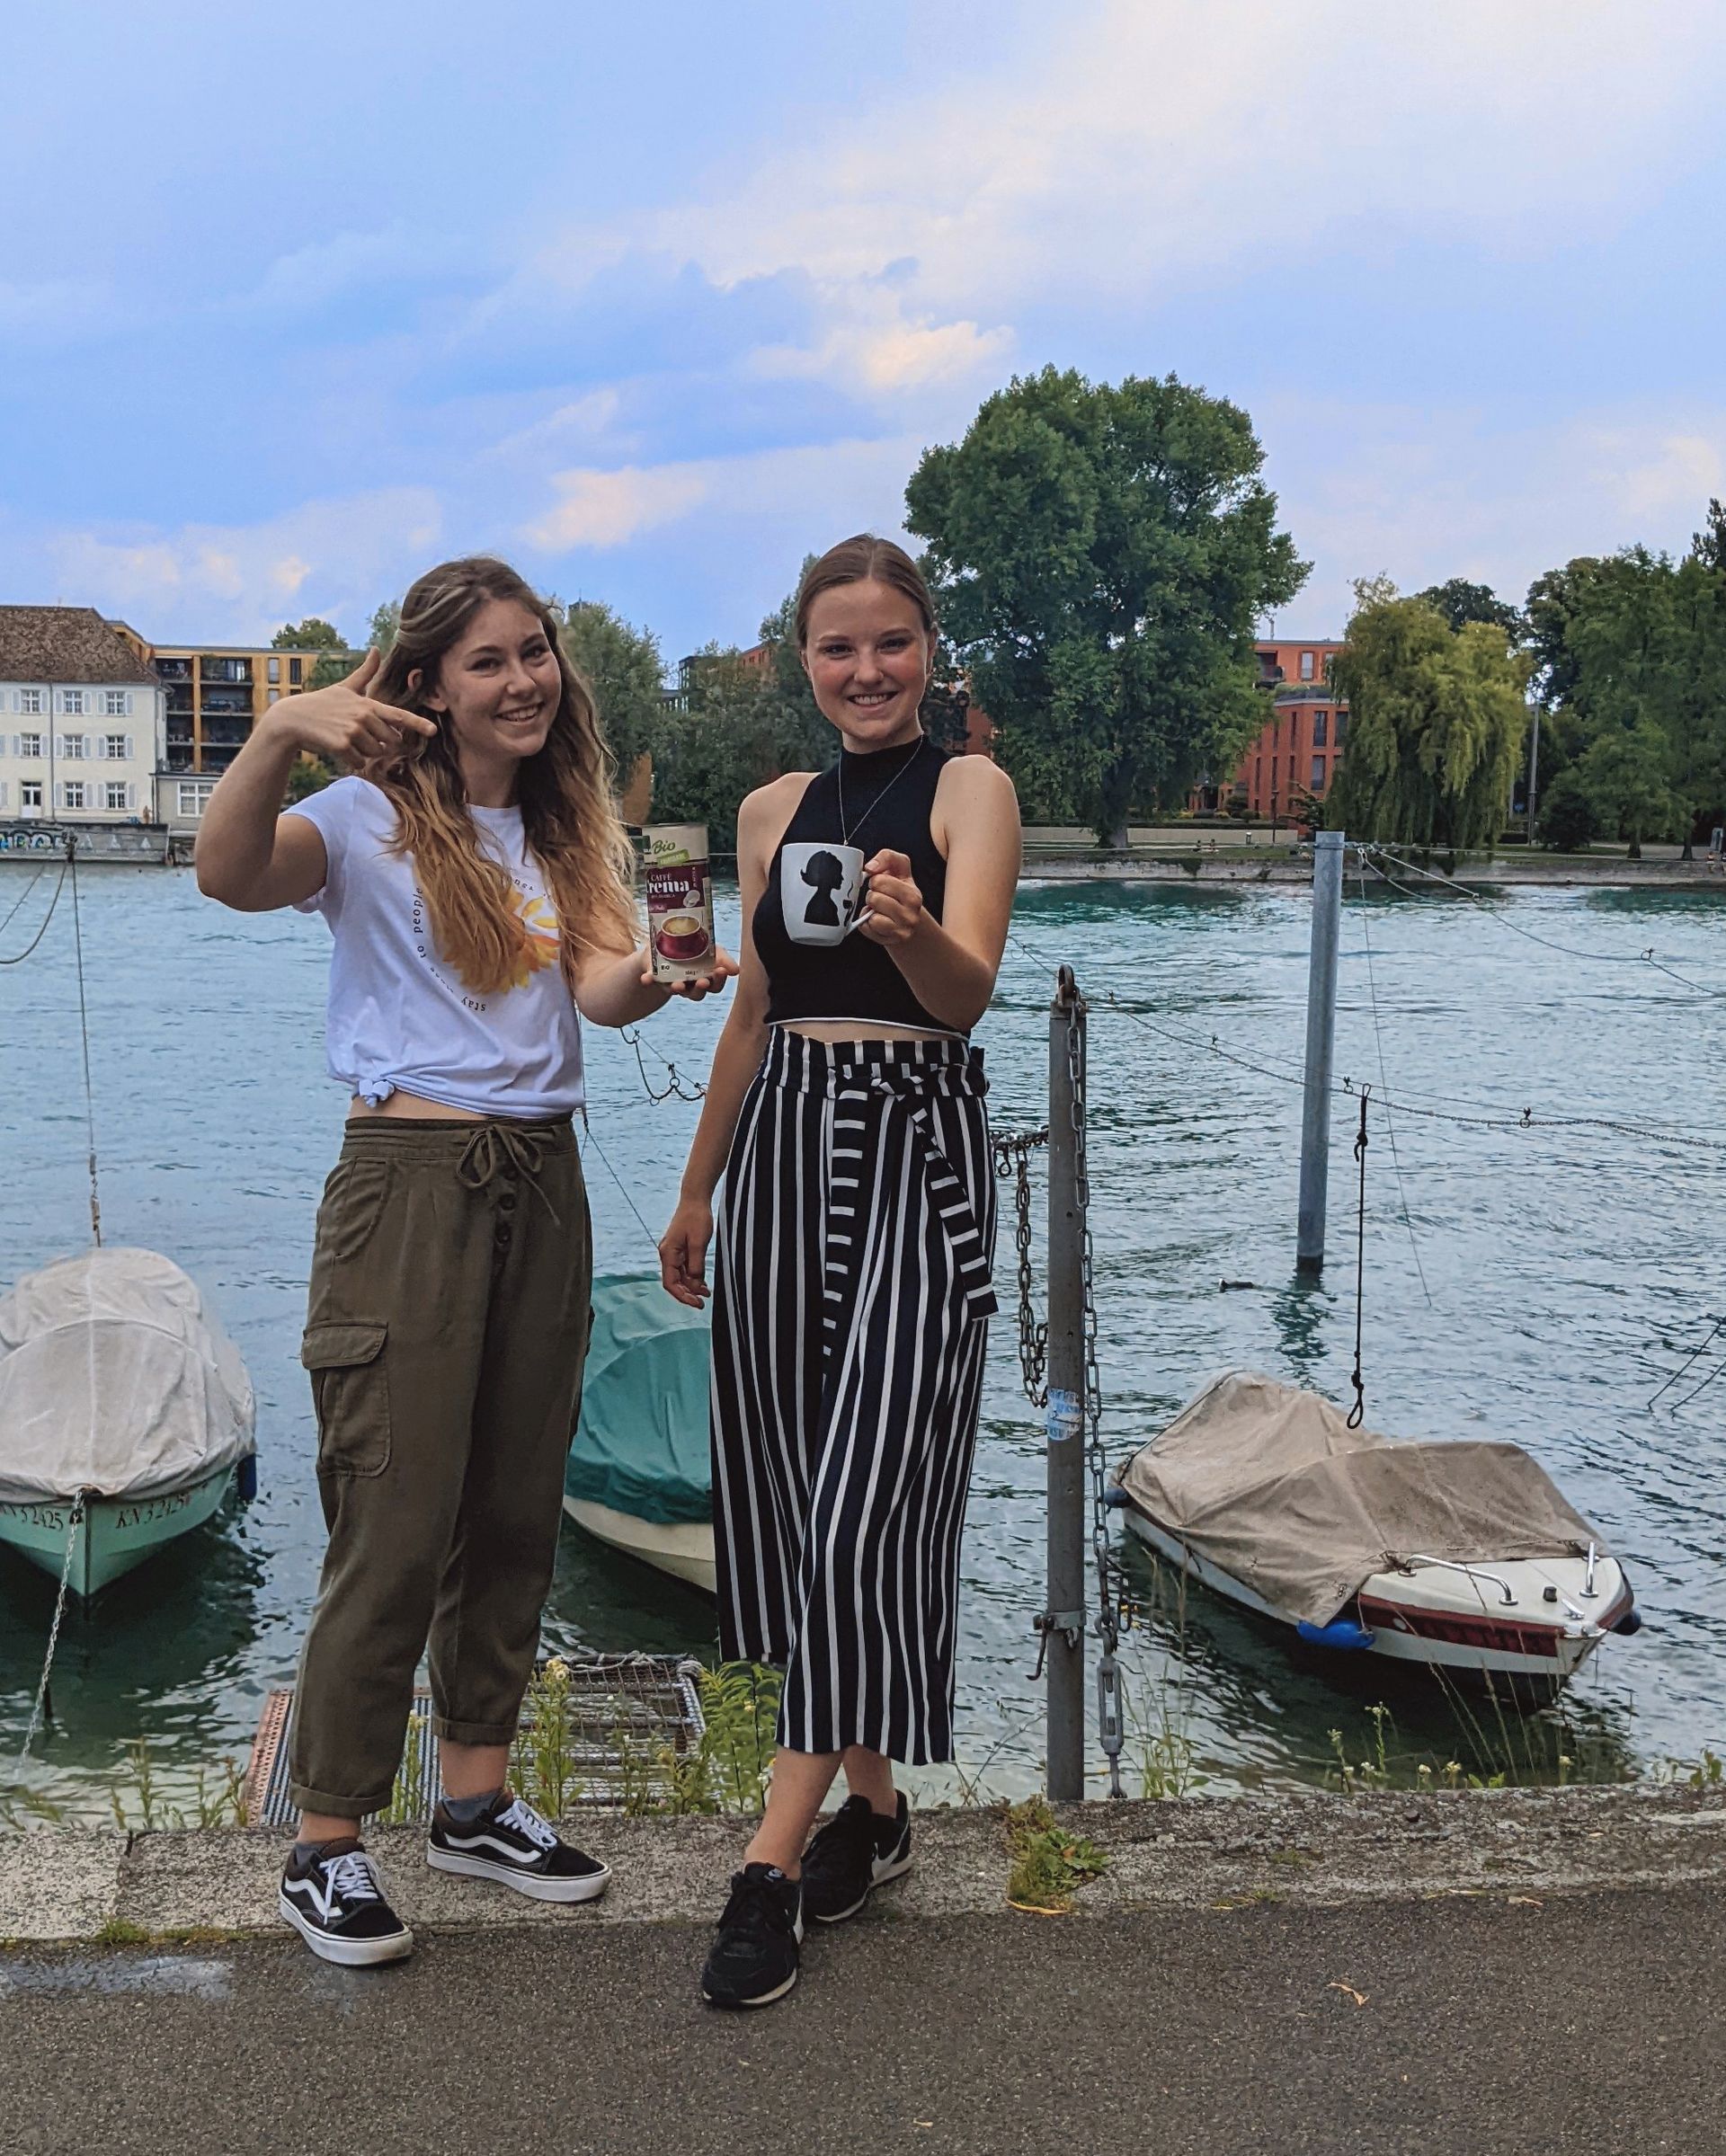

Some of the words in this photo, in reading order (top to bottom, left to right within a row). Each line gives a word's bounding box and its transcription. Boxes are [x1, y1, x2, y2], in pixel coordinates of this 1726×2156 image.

[652, 839, 675, 855] Bio
[412, 886, 423, 934] people
[461, 996, 486, 1012] stay
